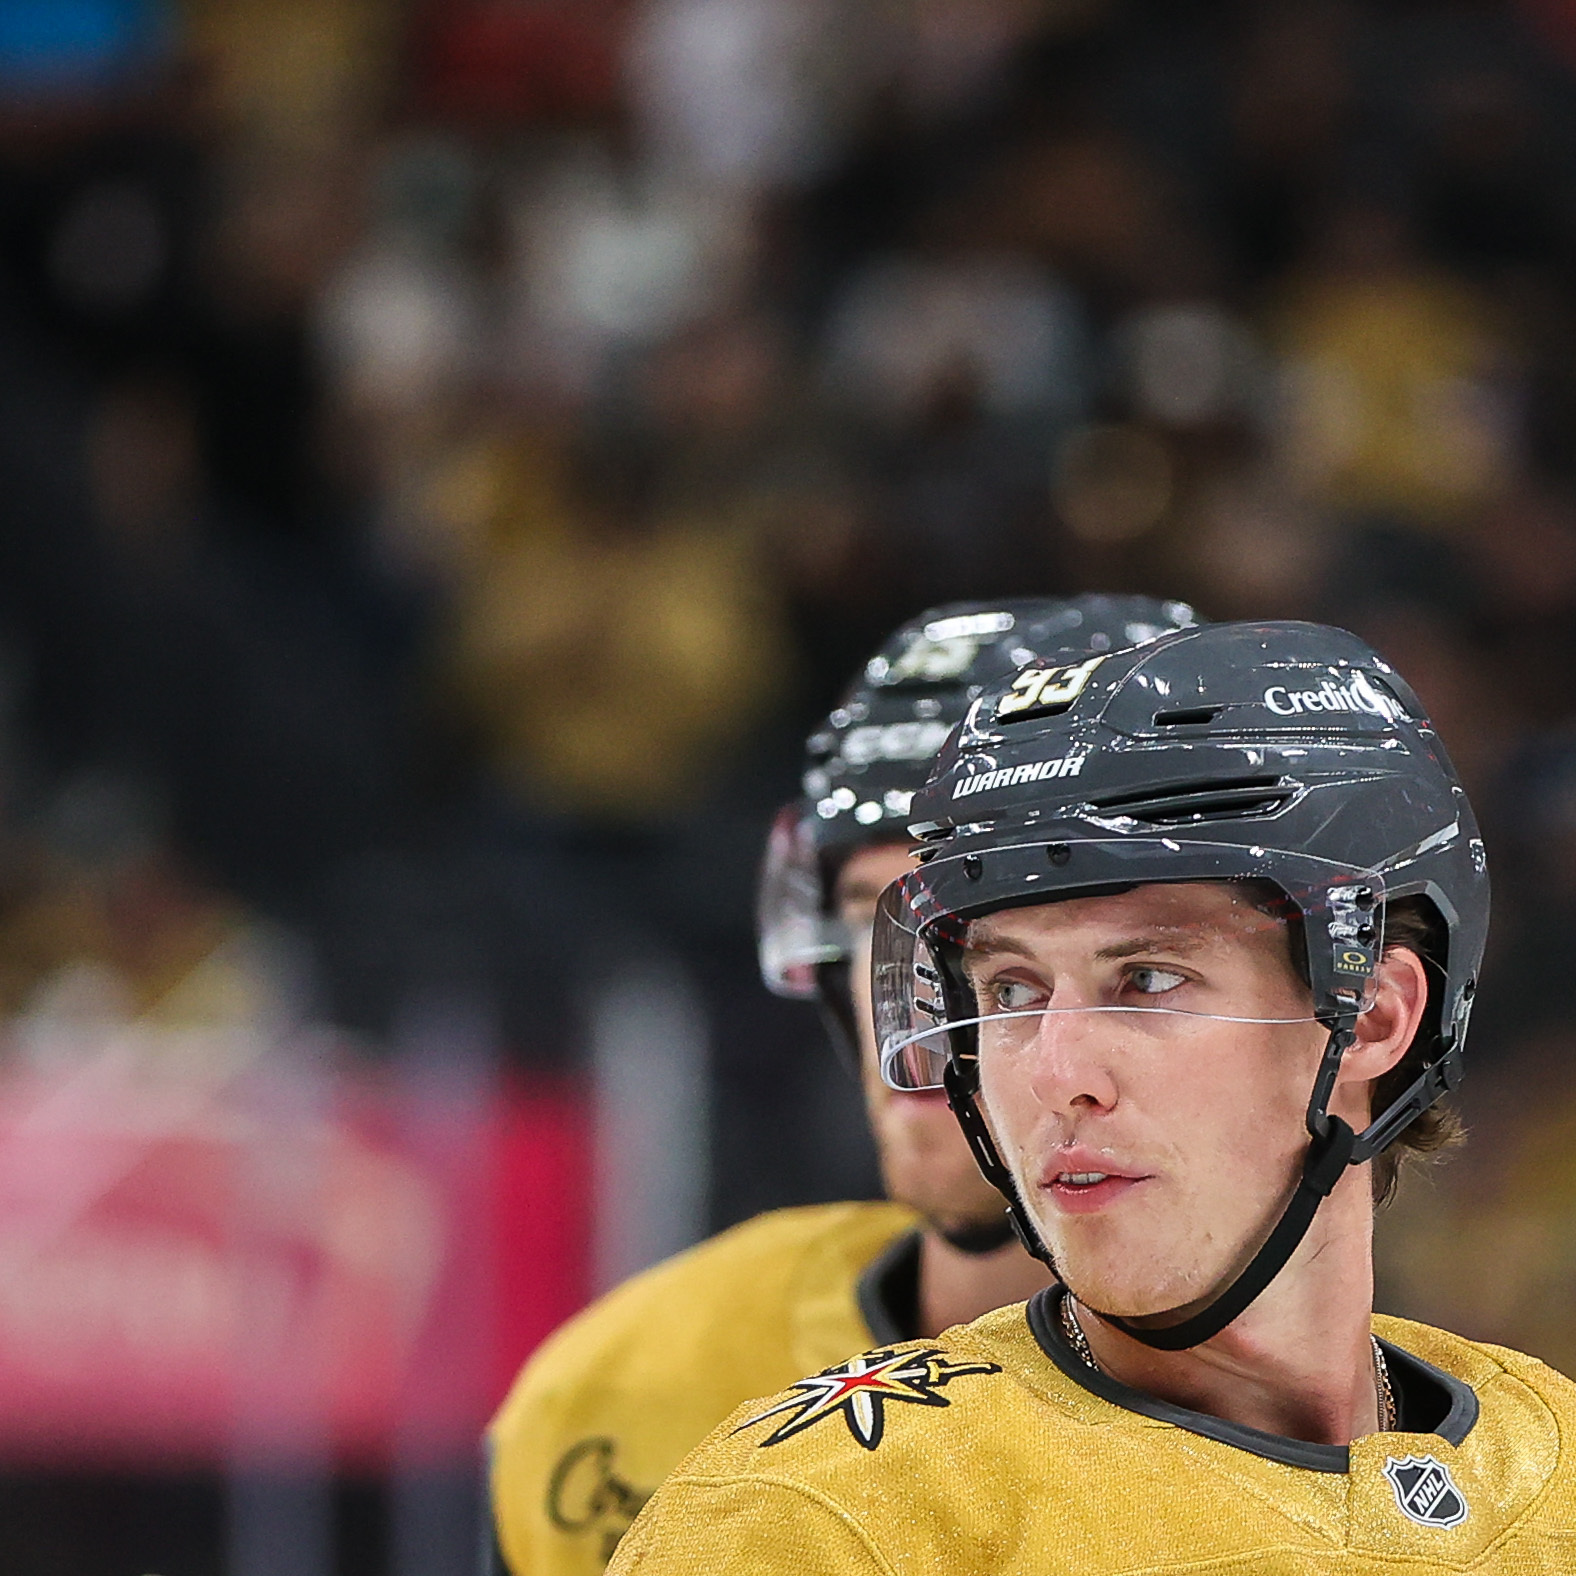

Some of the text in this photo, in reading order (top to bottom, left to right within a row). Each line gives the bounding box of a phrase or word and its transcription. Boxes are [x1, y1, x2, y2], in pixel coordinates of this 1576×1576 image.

[997, 655, 1108, 715] 93
[1264, 678, 1414, 723] CreditOne
[952, 755, 1086, 800] WARRIOR
[1413, 1472, 1445, 1515] NHL
